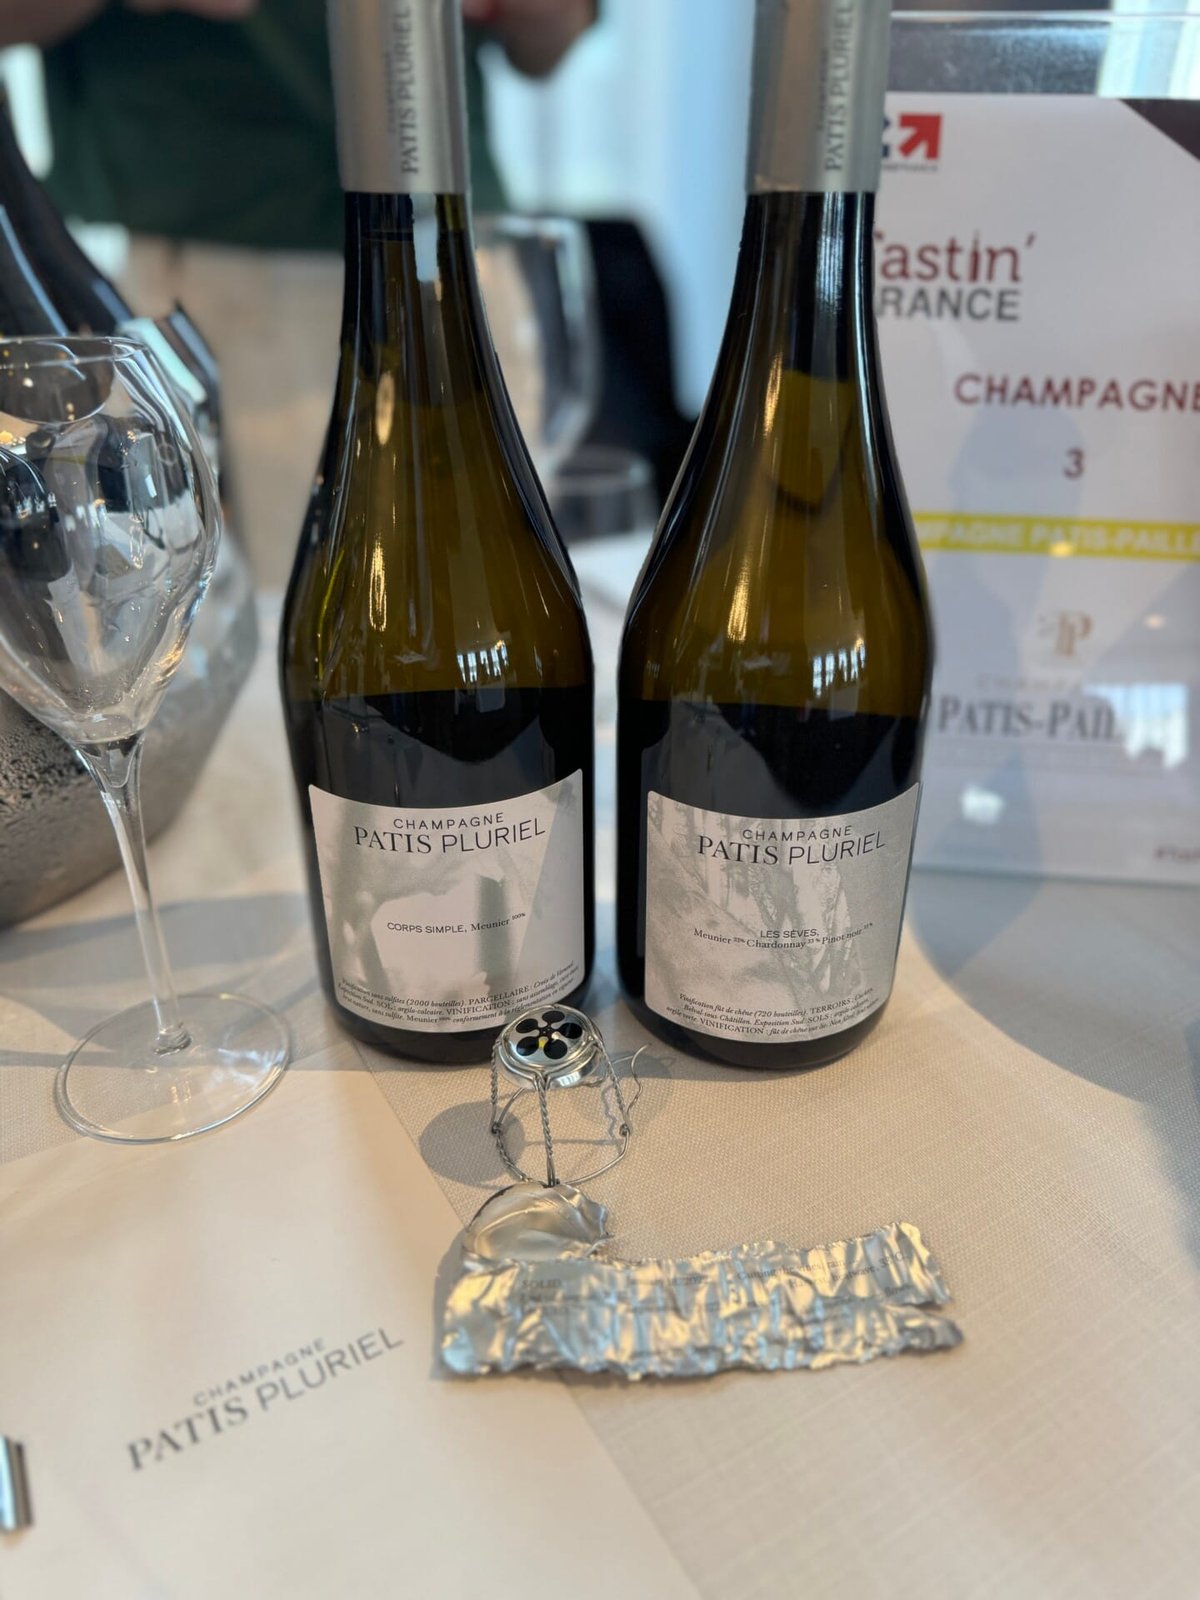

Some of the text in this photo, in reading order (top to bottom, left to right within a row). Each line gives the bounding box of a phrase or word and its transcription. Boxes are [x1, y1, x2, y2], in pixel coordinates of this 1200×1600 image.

[392, 7, 419, 174] PATIS PLURIEL
[824, 103, 847, 171] PATIS
[873, 230, 1036, 284] astin'
[875, 286, 1021, 323] RANCE
[1063, 447, 1085, 480] 3
[393, 812, 505, 830] CHAMPAGNE
[742, 825, 853, 842] CHAMPAGNE
[353, 816, 546, 854] PATIS PLURIEL
[697, 831, 886, 865] PATIS PLURIEL
[387, 922, 423, 933] CORPS
[424, 924, 468, 934] SIMPLE,
[471, 917, 510, 932] Meunier
[692, 928, 731, 945] Meunier
[747, 939, 806, 950] Chardonnay
[822, 934, 845, 945] Pinot
[846, 929, 862, 939] noir
[760, 930, 780, 939] LES
[406, 998, 430, 1007] (2000
[726, 1006, 734, 1014] de
[754, 1010, 773, 1019] (720
[406, 1014, 438, 1024] Meunier
[753, 1019, 790, 1028] Exposition
[192, 1337, 326, 1408] CHAMPAGNE
[127, 1326, 406, 1473] PATIS PLURIEL
